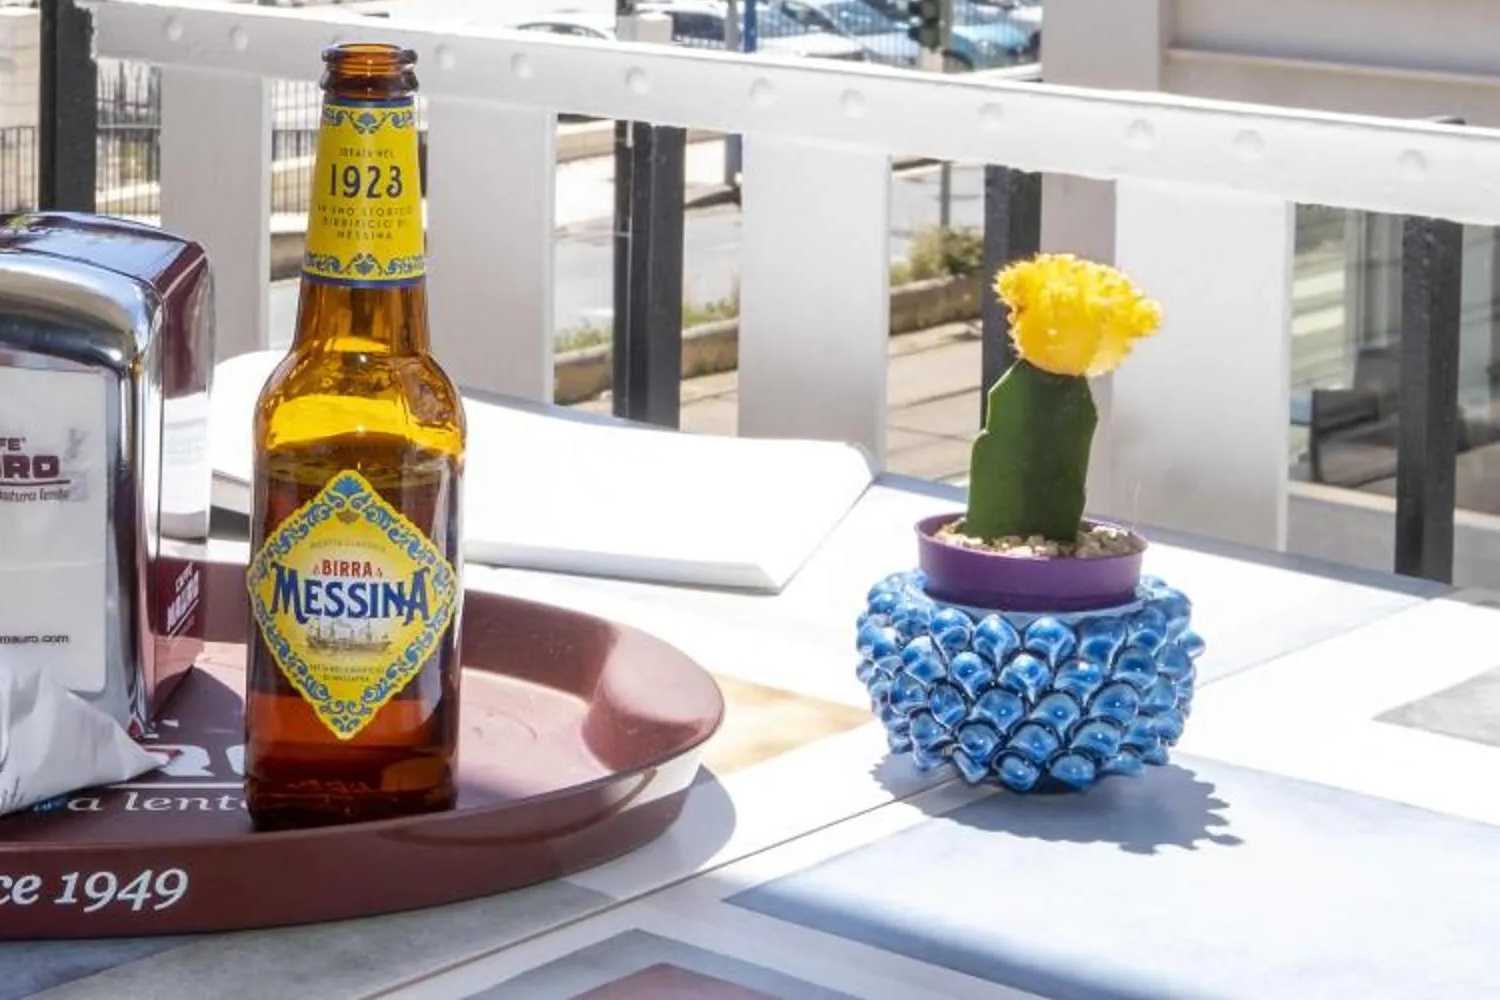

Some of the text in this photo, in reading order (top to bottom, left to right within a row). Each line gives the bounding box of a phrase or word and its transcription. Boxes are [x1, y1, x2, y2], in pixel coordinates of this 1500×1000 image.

[329, 163, 403, 199] 1923
[321, 559, 373, 578] BIRRA
[269, 561, 431, 626] MESSINA
[124, 791, 247, 812] lent
[54, 868, 190, 913] 1949
